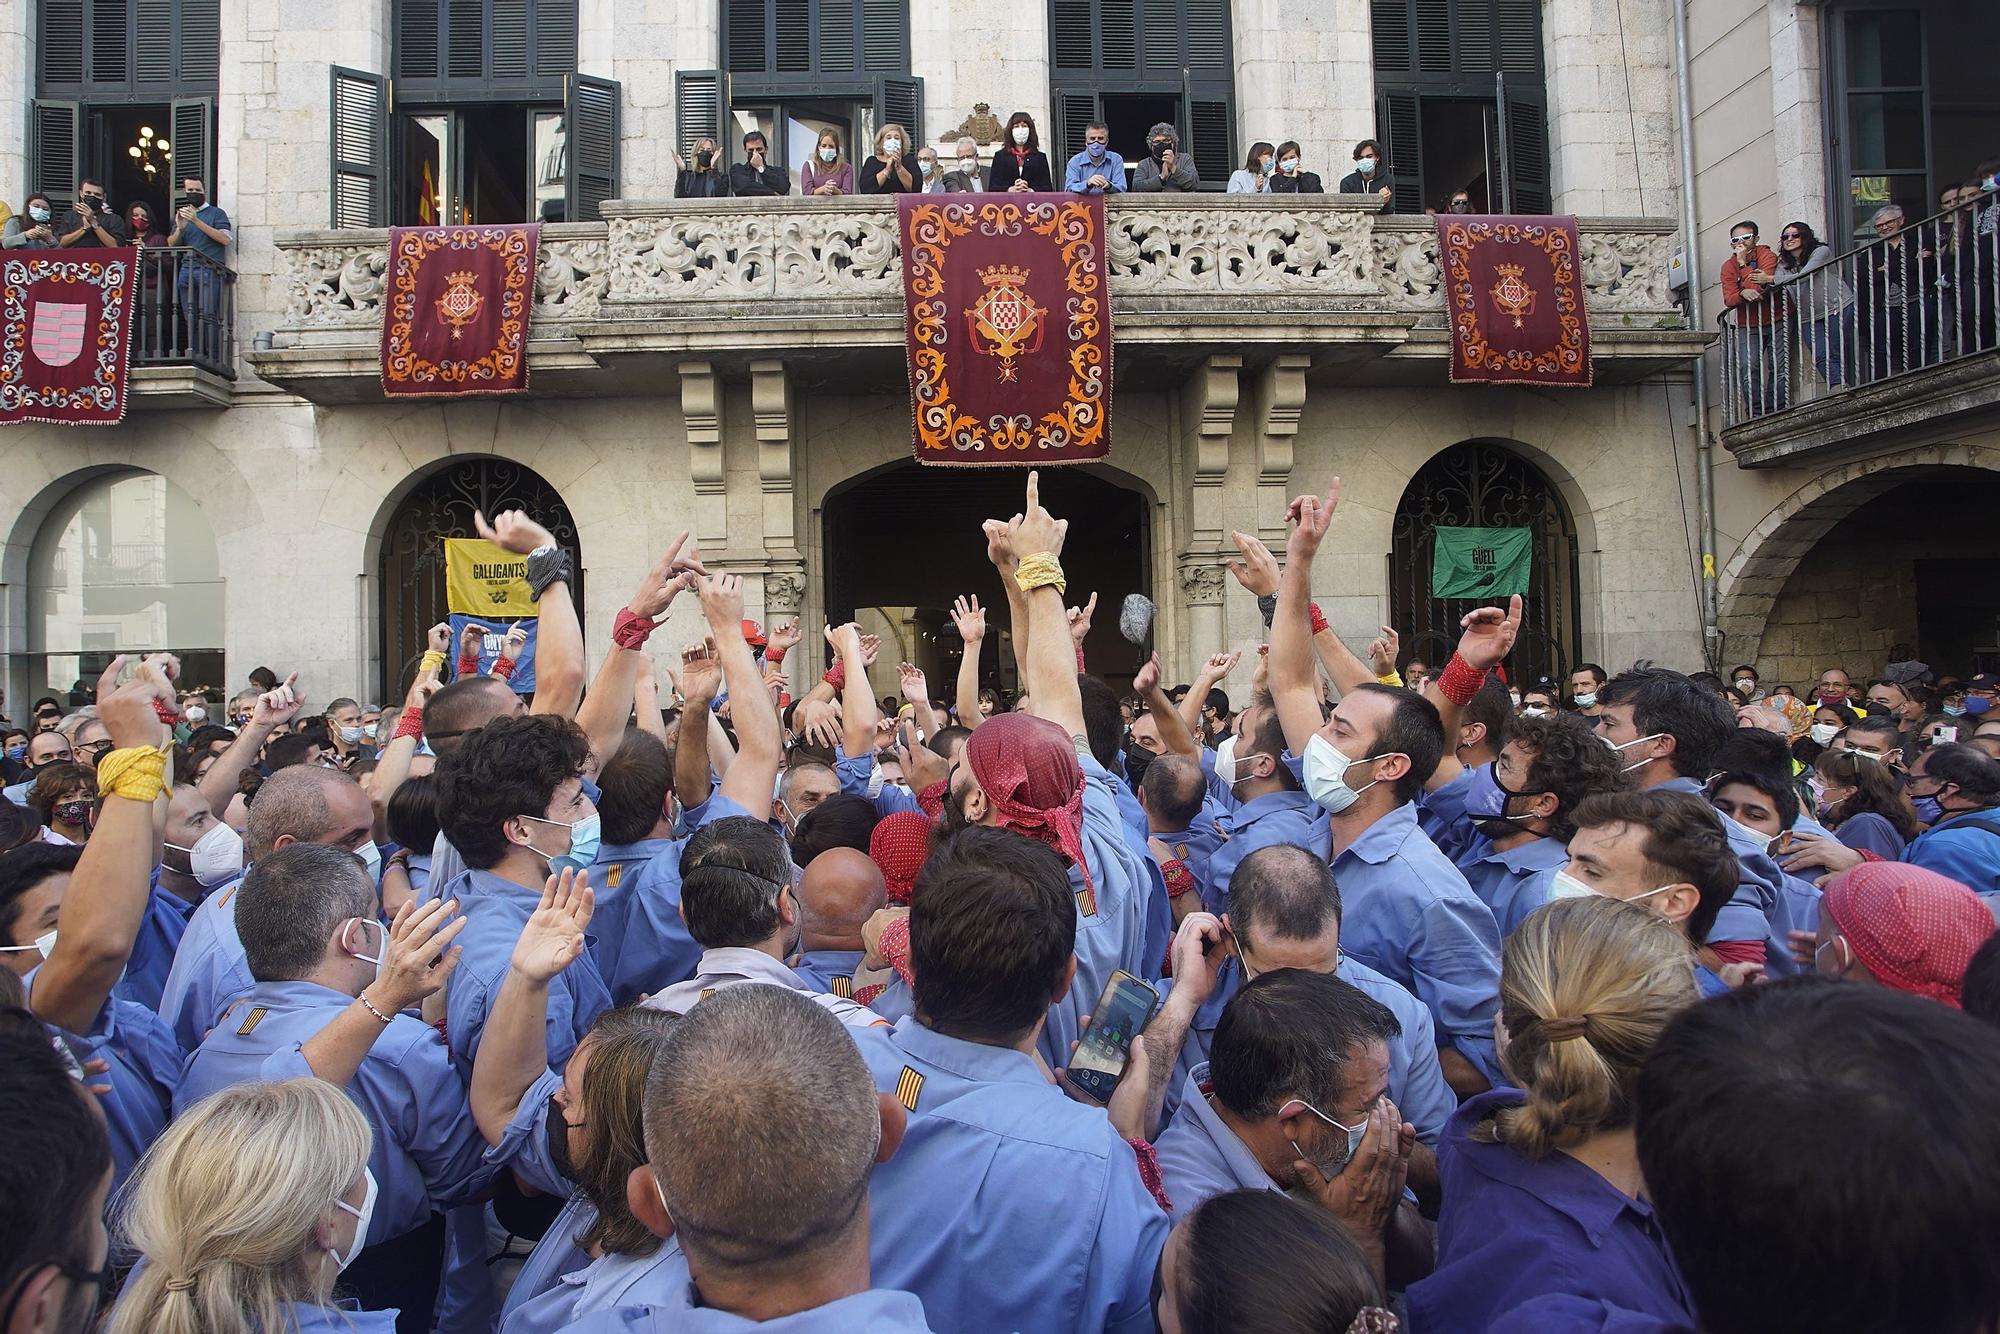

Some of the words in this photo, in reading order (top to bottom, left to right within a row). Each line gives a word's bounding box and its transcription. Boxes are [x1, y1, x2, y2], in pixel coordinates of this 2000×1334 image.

[1472, 545, 1497, 565] GÜELL
[473, 563, 525, 579] GALLIGANTS
[484, 633, 505, 651] ONY
